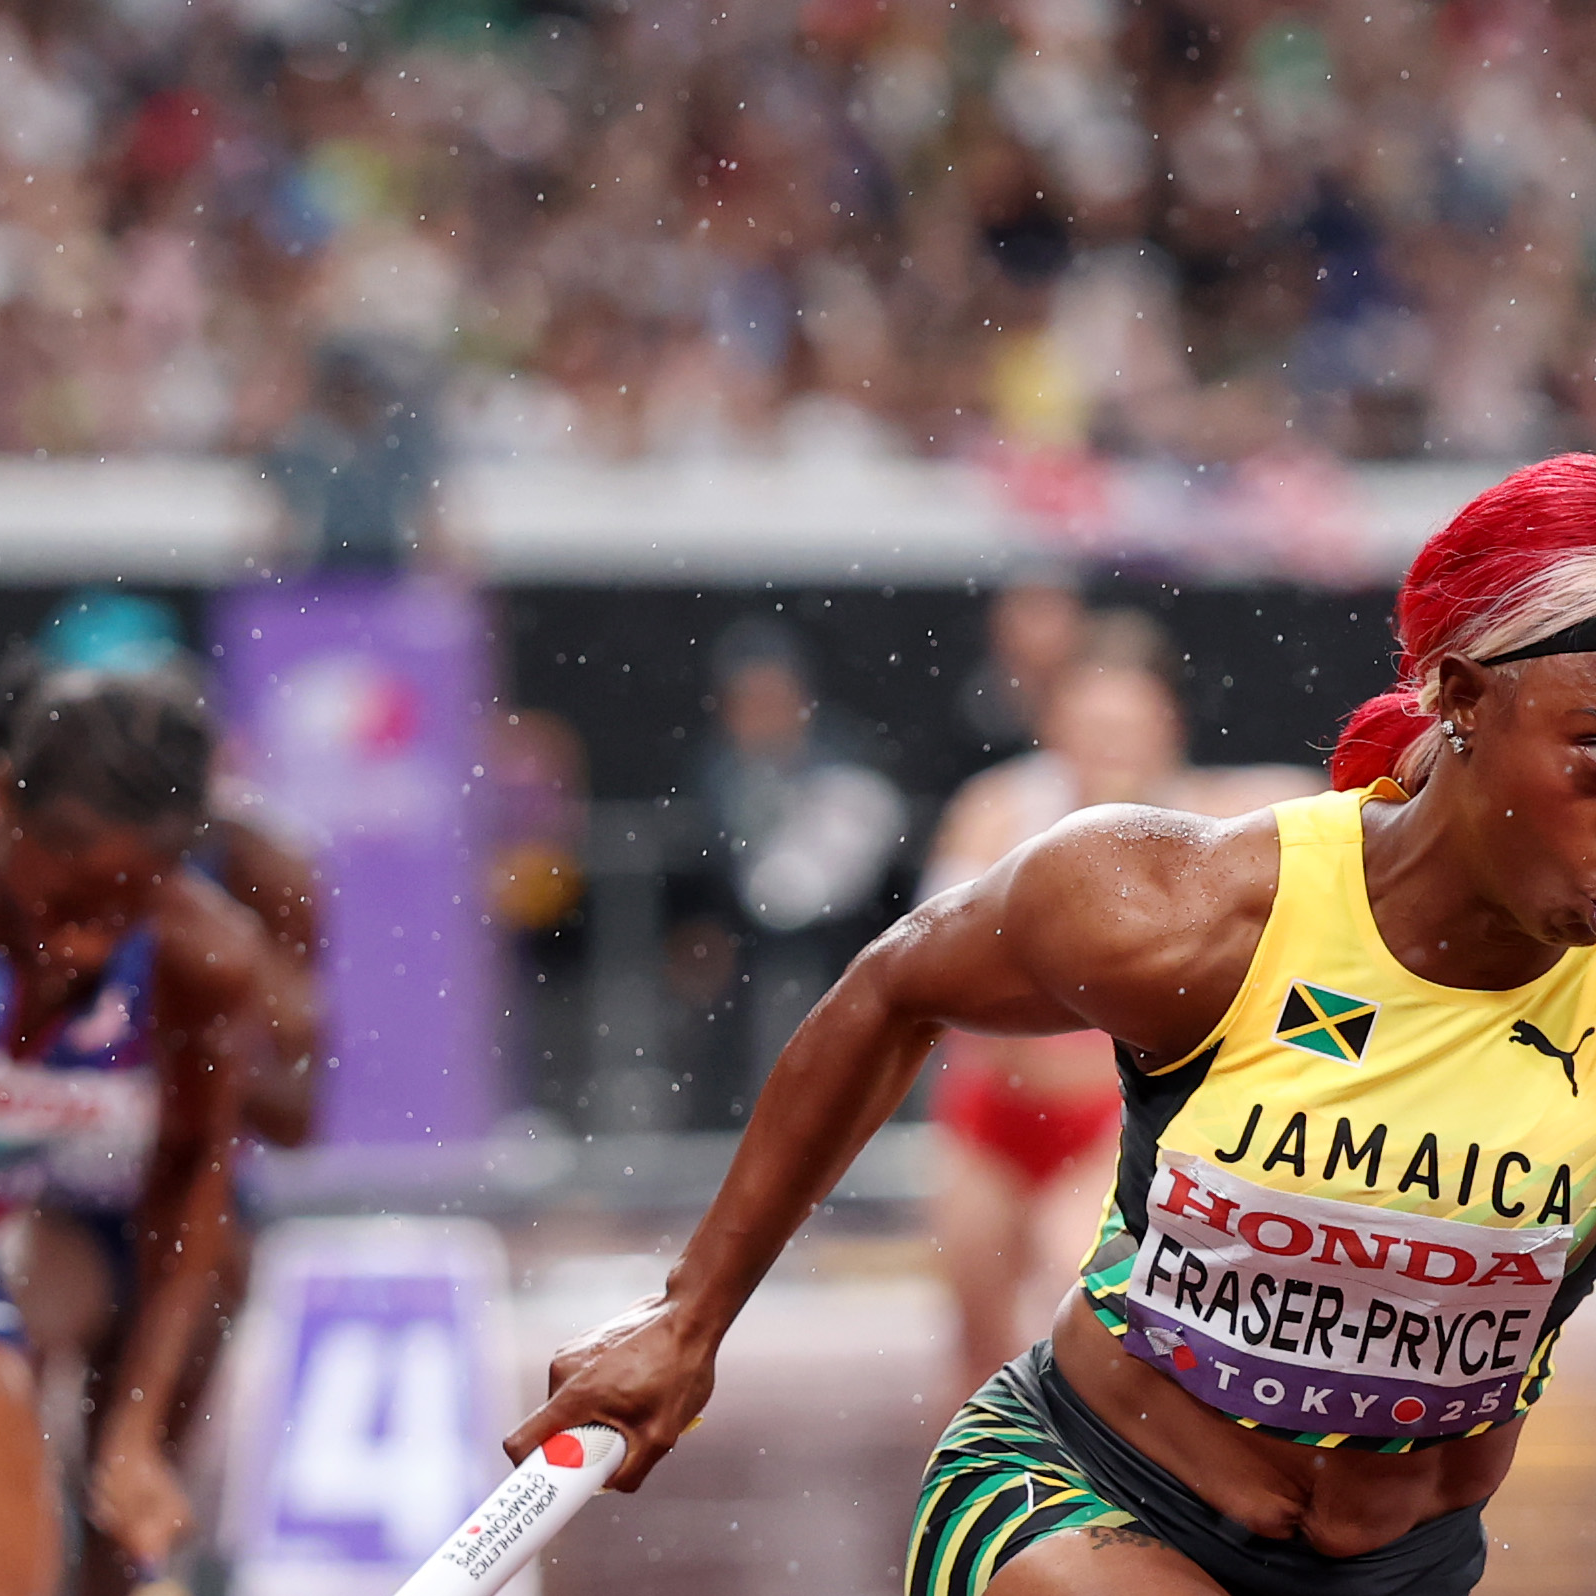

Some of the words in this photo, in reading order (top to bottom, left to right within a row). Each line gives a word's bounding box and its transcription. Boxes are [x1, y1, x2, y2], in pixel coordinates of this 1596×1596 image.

[1215, 1104, 1571, 1225] JAMAICA
[1157, 1168, 1552, 1287] HONDA
[1145, 1233, 1531, 1376] FRASER-PRYCE
[288, 1316, 468, 1560] 4
[456, 1473, 546, 1568] CHAMPIONSHIPS
[469, 1521, 523, 1581] ATHLETICS
[522, 1483, 559, 1525] WORLD
